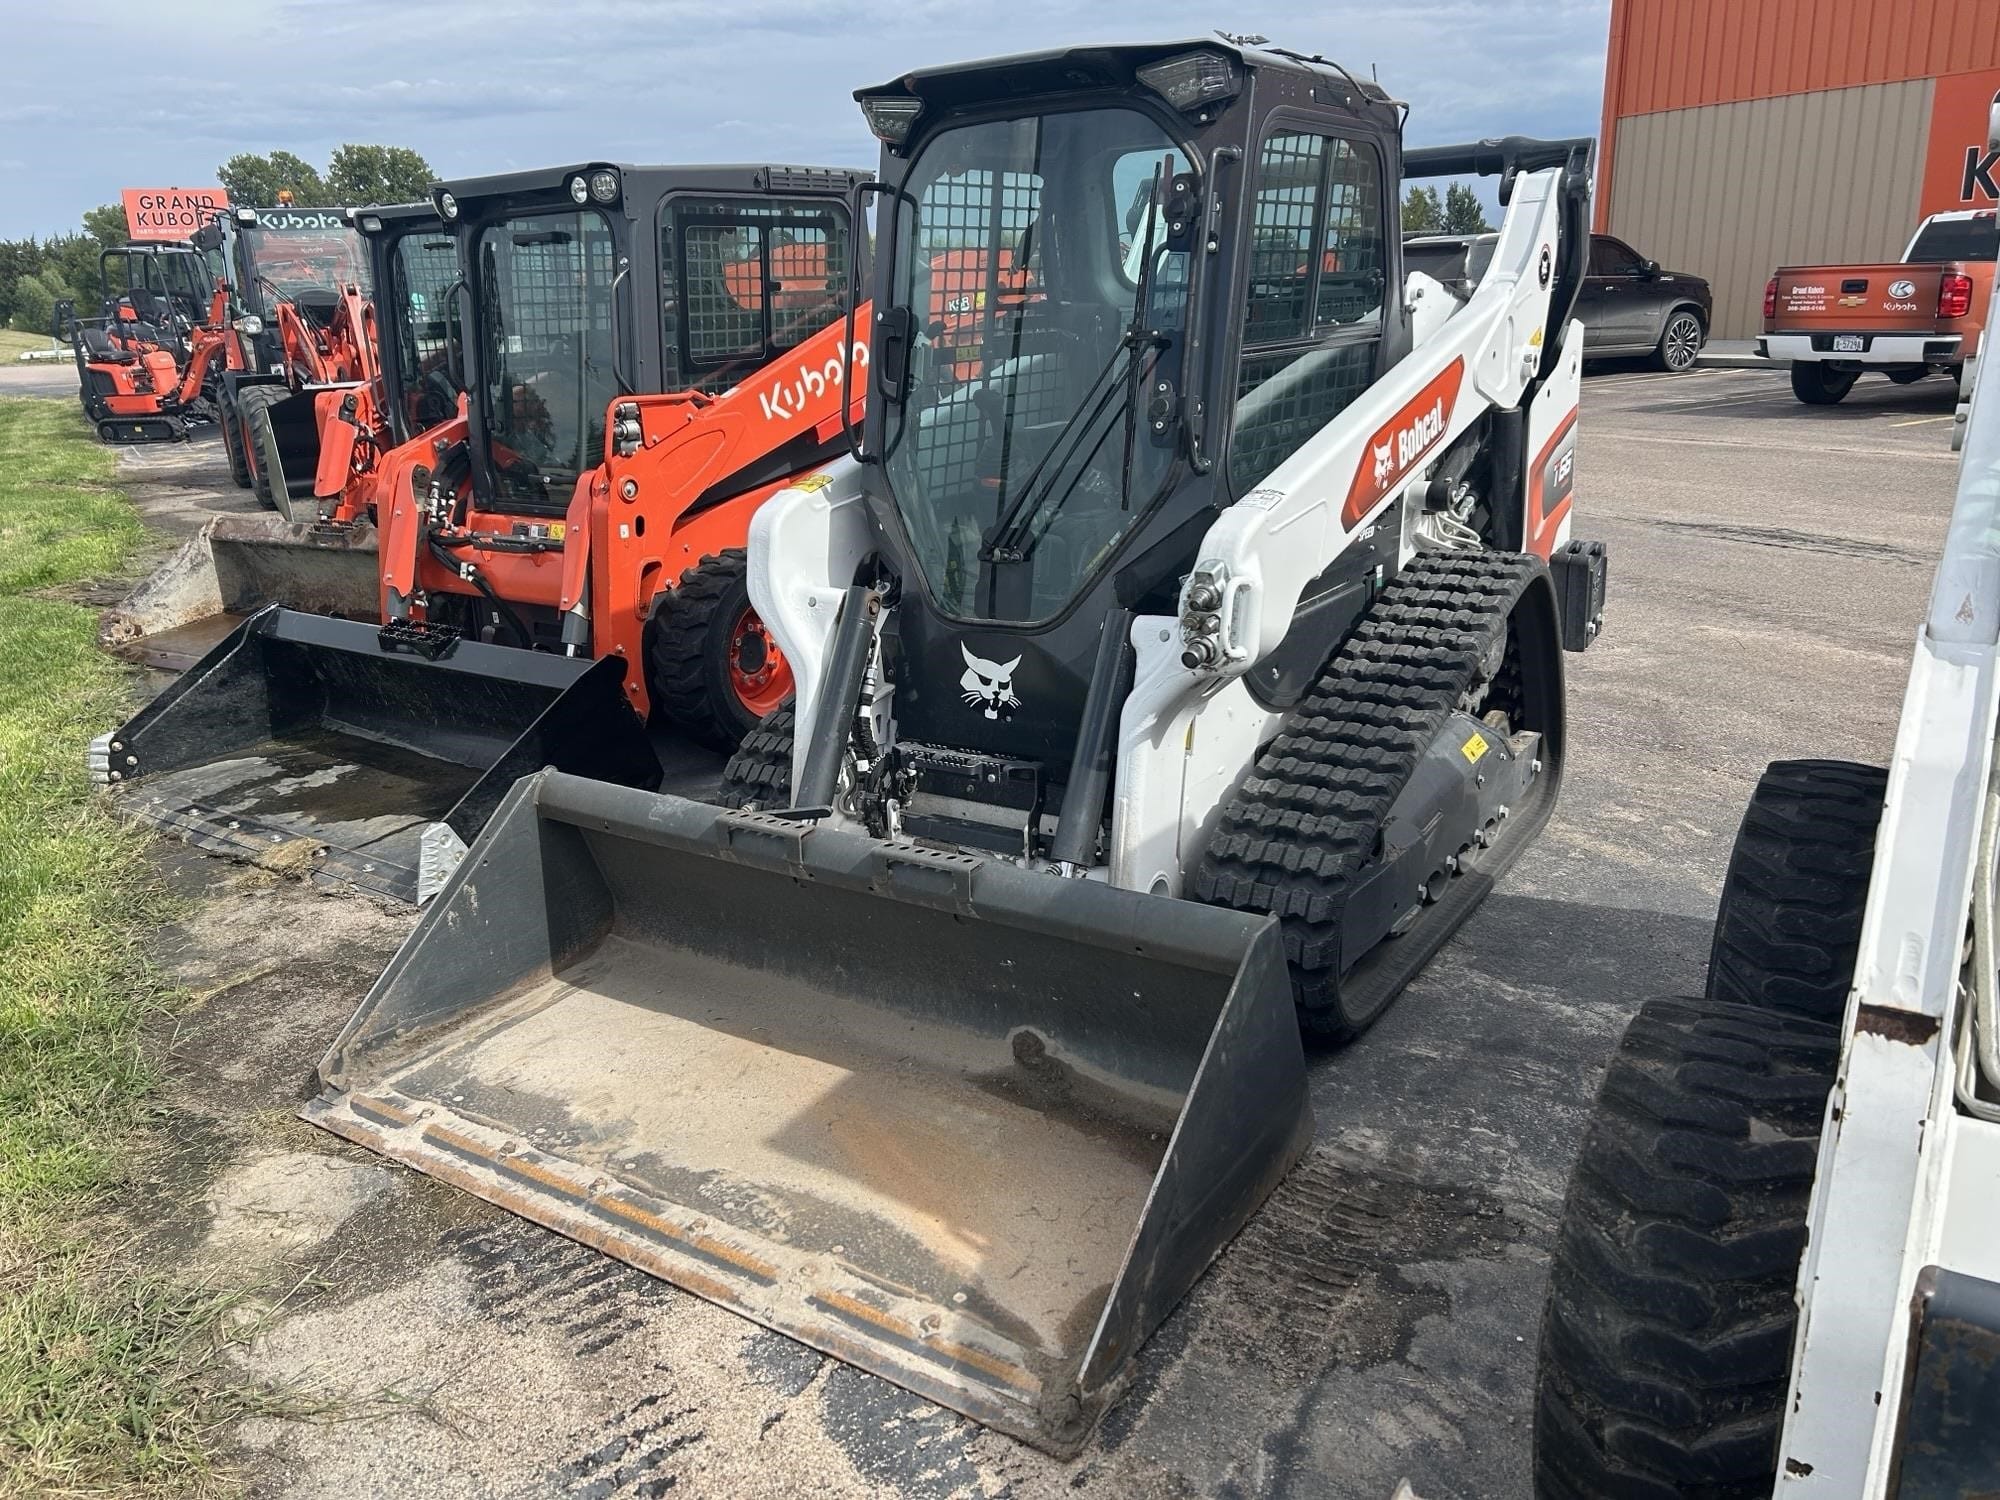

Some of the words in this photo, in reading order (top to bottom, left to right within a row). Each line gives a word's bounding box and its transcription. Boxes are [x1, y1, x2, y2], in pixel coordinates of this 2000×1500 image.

[140, 195, 214, 210] GRAND
[256, 213, 343, 229] Kubota
[1883, 302, 1918, 312] Kubota
[1398, 396, 1446, 471] Bobcat
